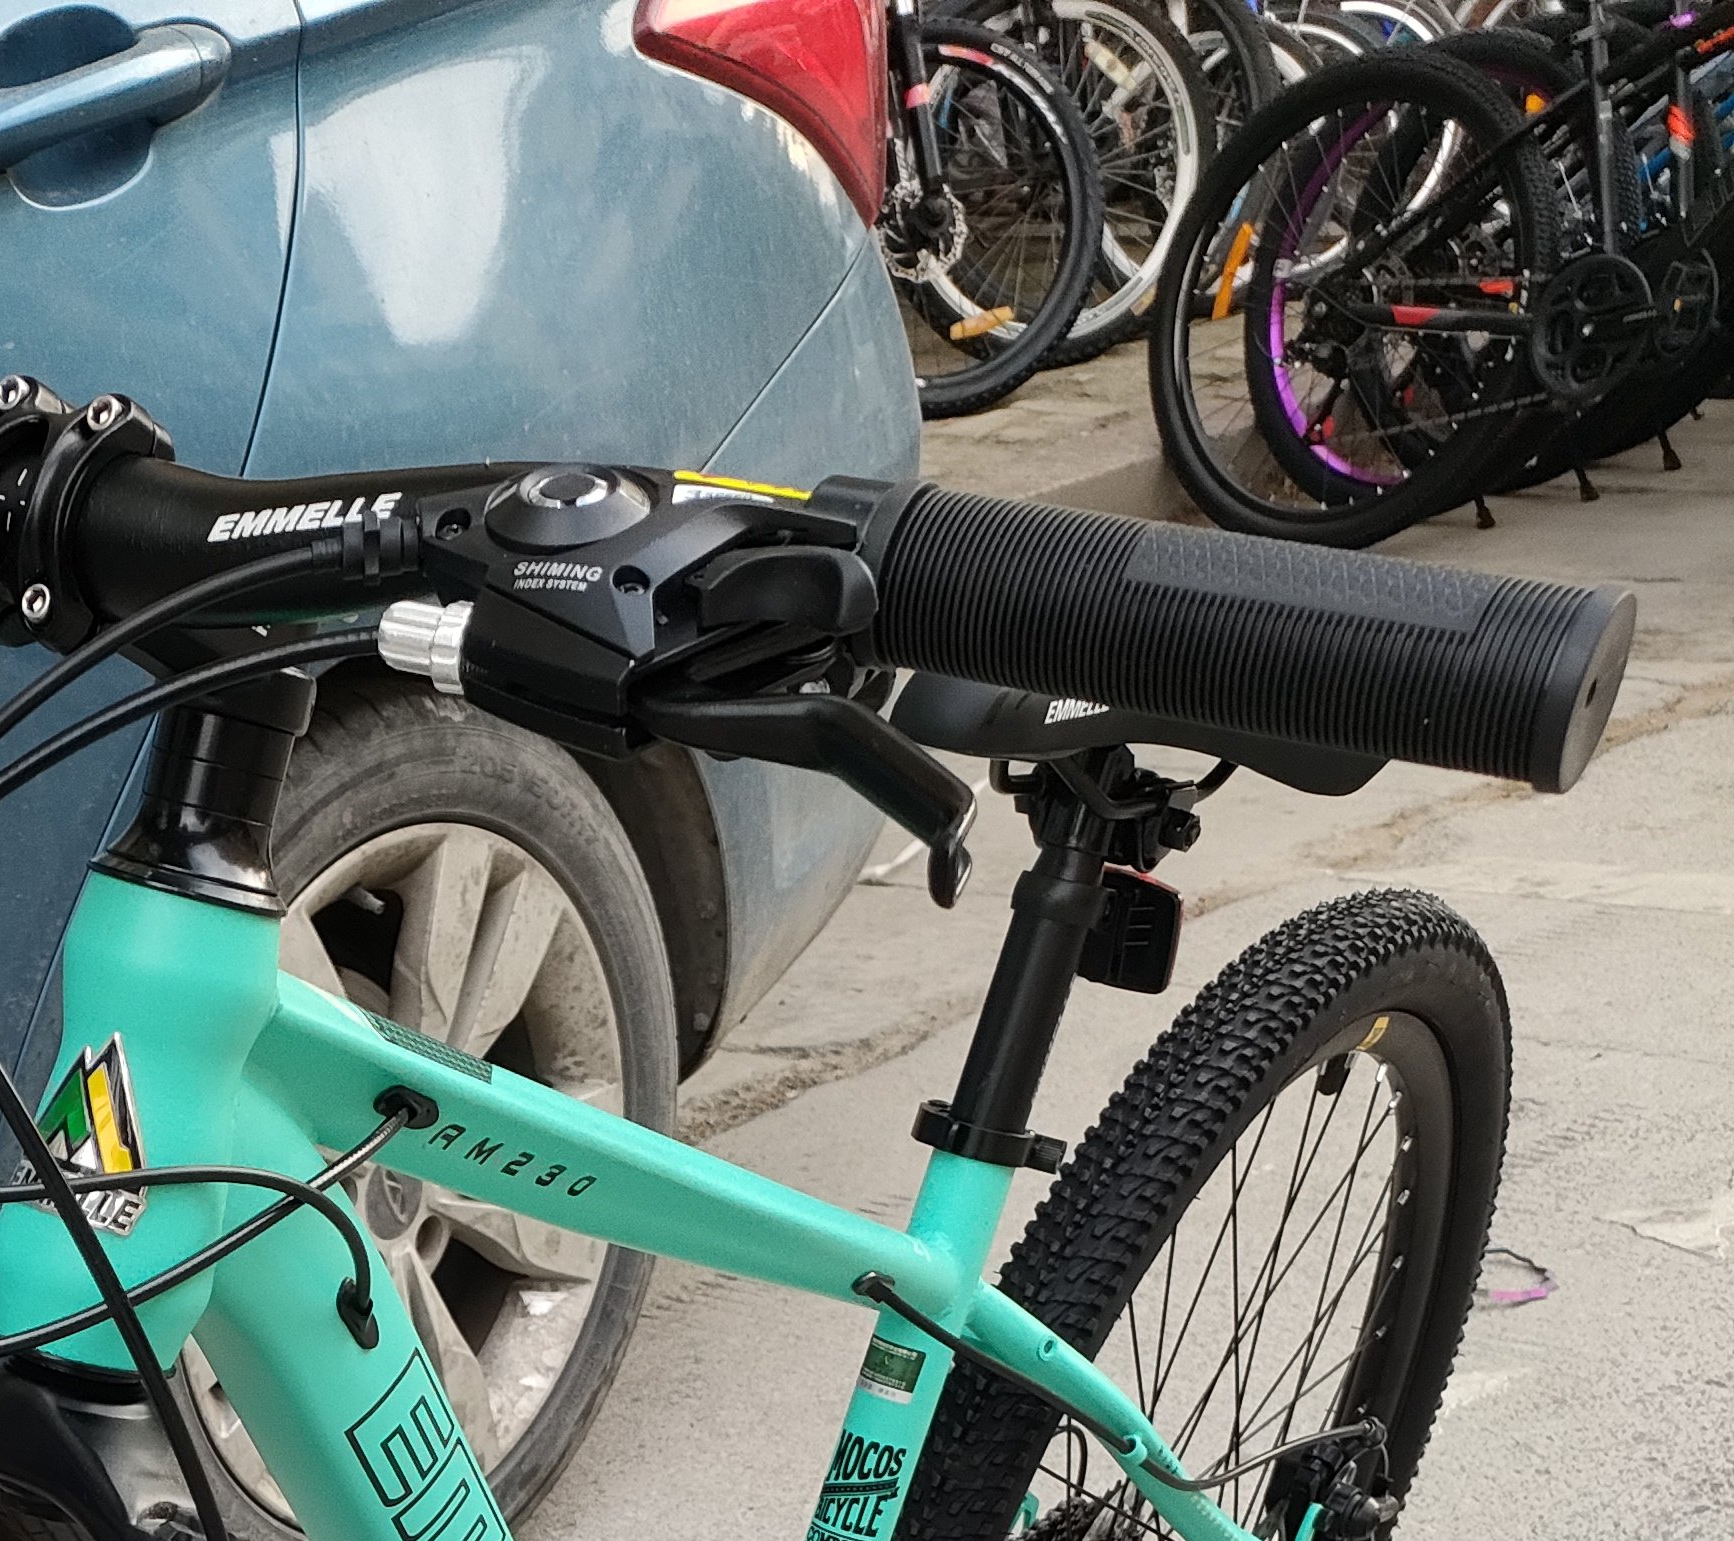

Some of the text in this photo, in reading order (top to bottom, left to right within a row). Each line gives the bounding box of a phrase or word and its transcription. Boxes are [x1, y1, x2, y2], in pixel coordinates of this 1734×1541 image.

[207, 491, 403, 543] EMMELLE
[513, 561, 603, 582] SHIMING
[513, 578, 588, 592] INDEX SYSTEM
[825, 1428, 907, 1482] MOCOS
